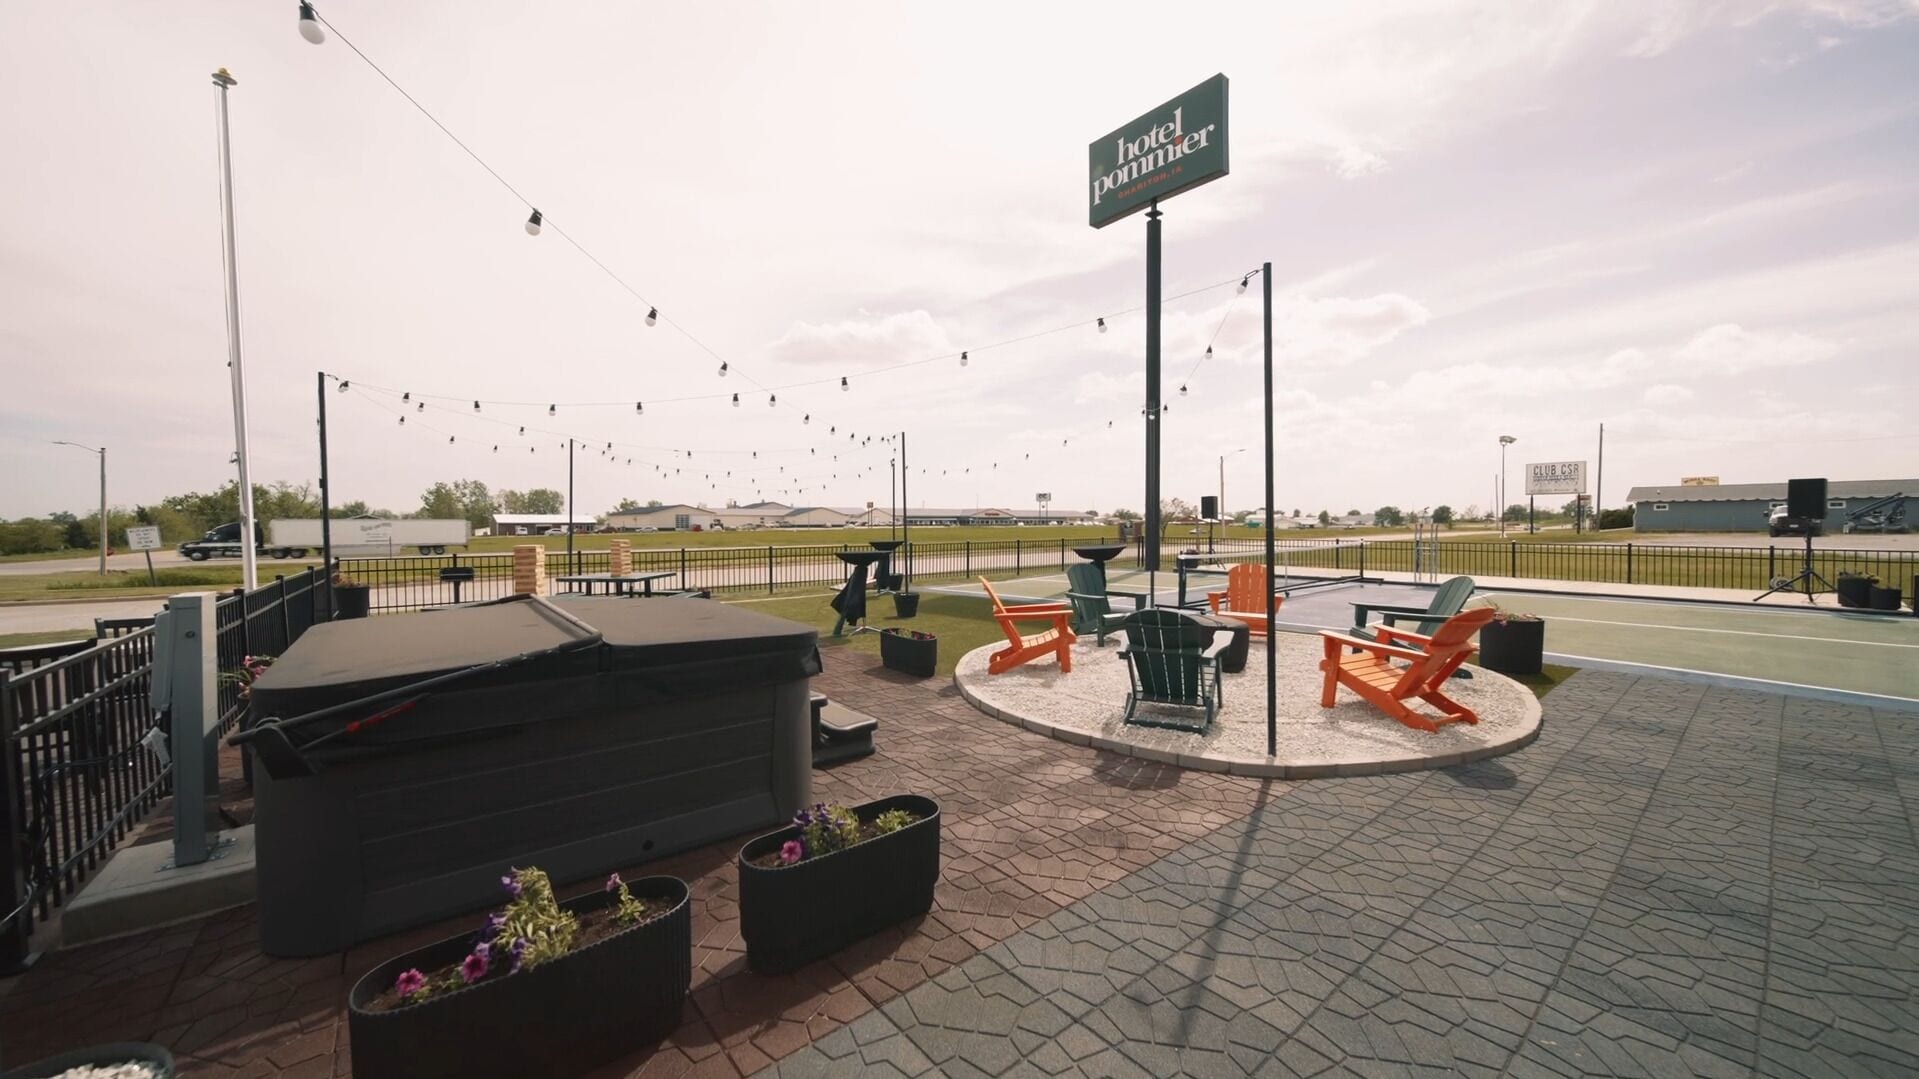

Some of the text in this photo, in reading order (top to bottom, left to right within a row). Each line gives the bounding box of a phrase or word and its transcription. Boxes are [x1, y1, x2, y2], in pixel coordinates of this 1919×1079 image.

[1093, 124, 1215, 206] pommier
[1117, 107, 1184, 166] hotel
[1533, 464, 1557, 476] CLUB
